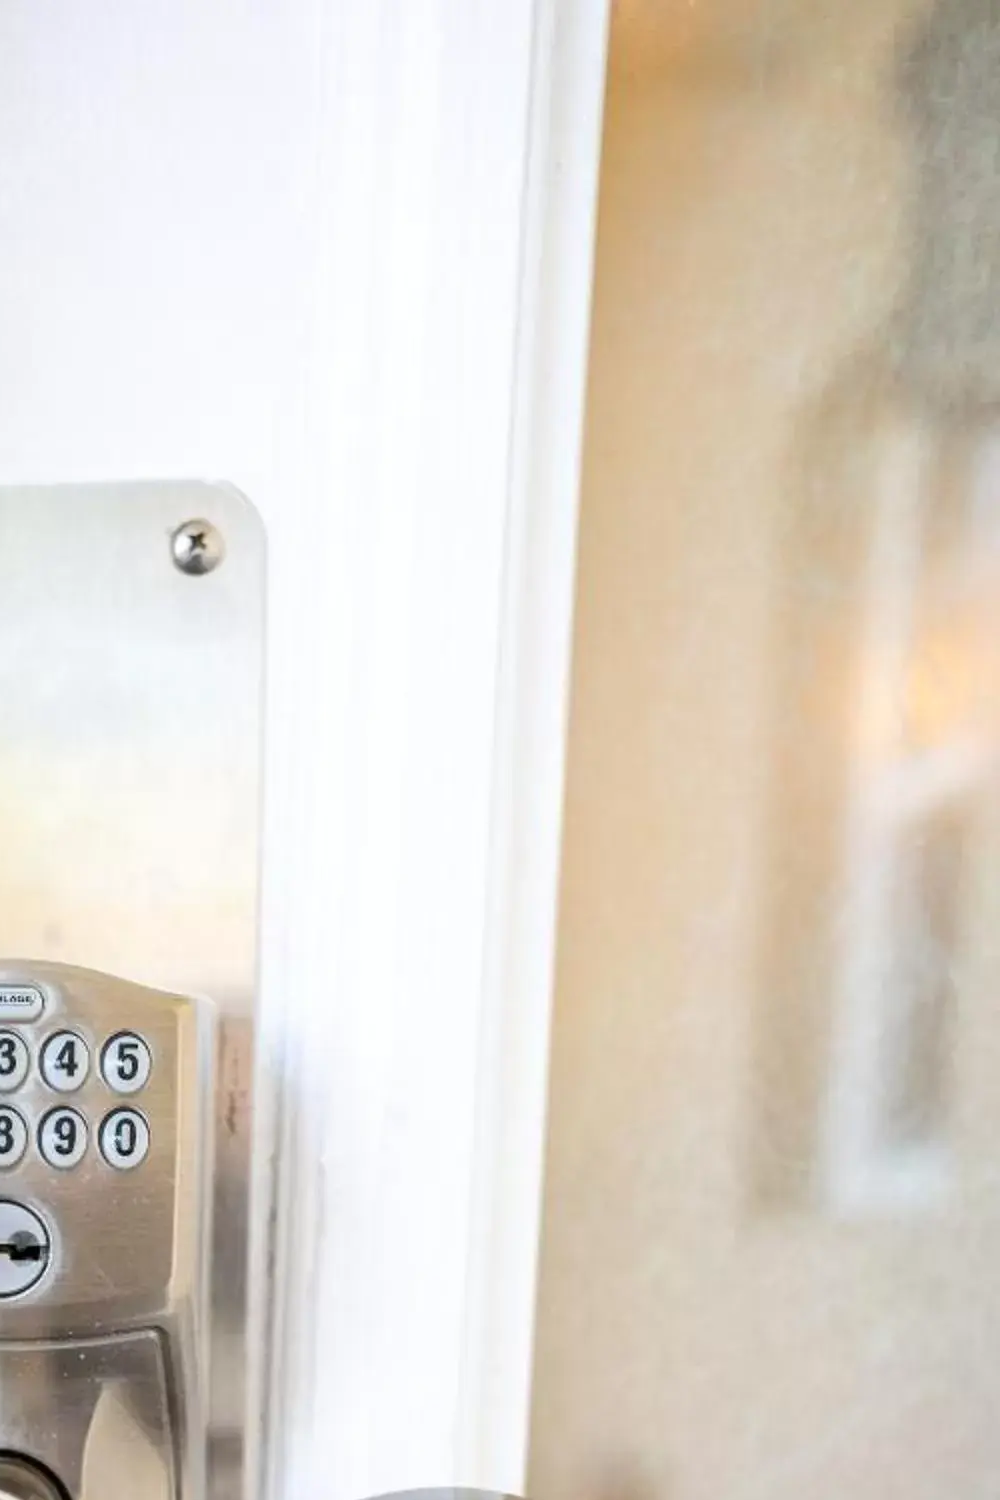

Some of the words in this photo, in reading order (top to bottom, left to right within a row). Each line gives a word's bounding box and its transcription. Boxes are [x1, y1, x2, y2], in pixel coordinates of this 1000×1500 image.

[54, 1040, 79, 1077] 4
[117, 1043, 139, 1080] 5
[54, 1116, 77, 1155] 9
[114, 1117, 137, 1157] 0
